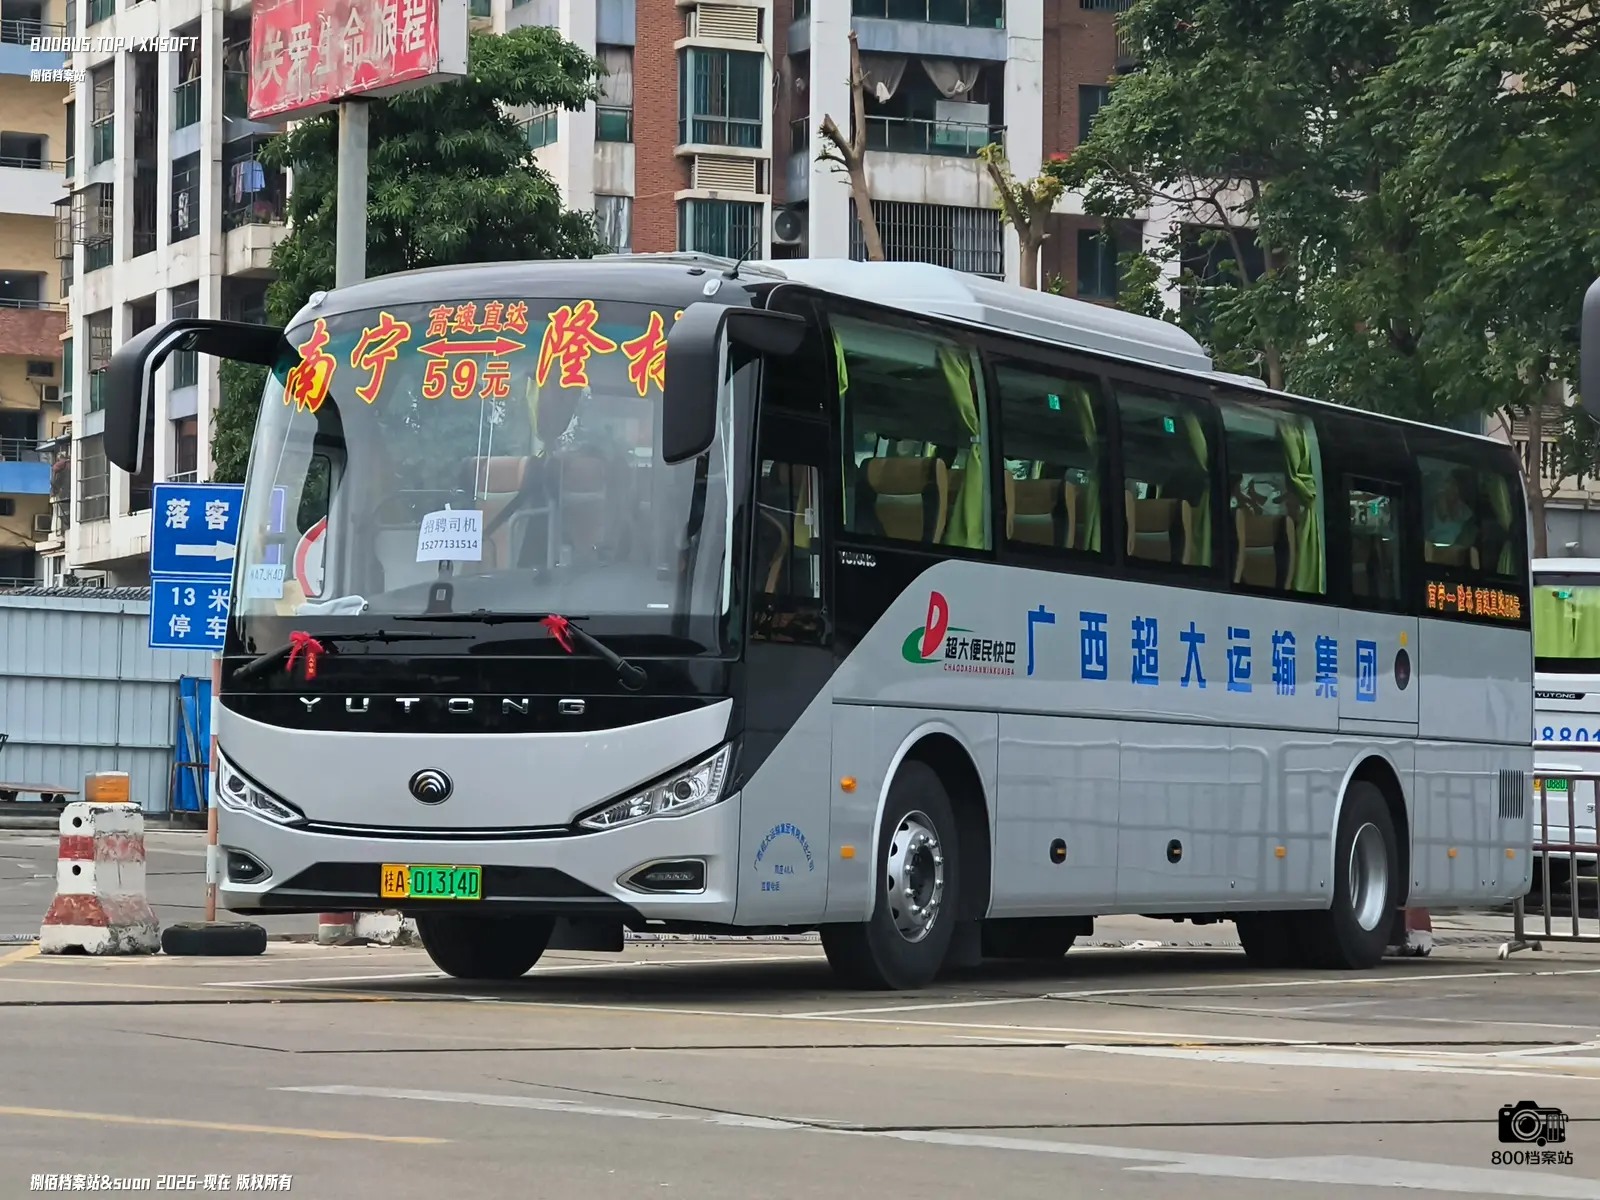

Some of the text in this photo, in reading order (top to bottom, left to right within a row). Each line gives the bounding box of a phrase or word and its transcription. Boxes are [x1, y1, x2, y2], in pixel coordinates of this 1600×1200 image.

[425, 300, 529, 338] 高速直达
[283, 311, 411, 413] 南宁
[422, 359, 511, 399] 59元
[165, 498, 230, 530] 落客
[424, 516, 477, 535] 招聘司机
[420, 539, 478, 551] 15277131514
[168, 614, 227, 640] 停车
[945, 636, 1016, 664] 超大便民快巴
[1027, 604, 1377, 703] 广西超大运输集团
[300, 697, 586, 714] YUTONG
